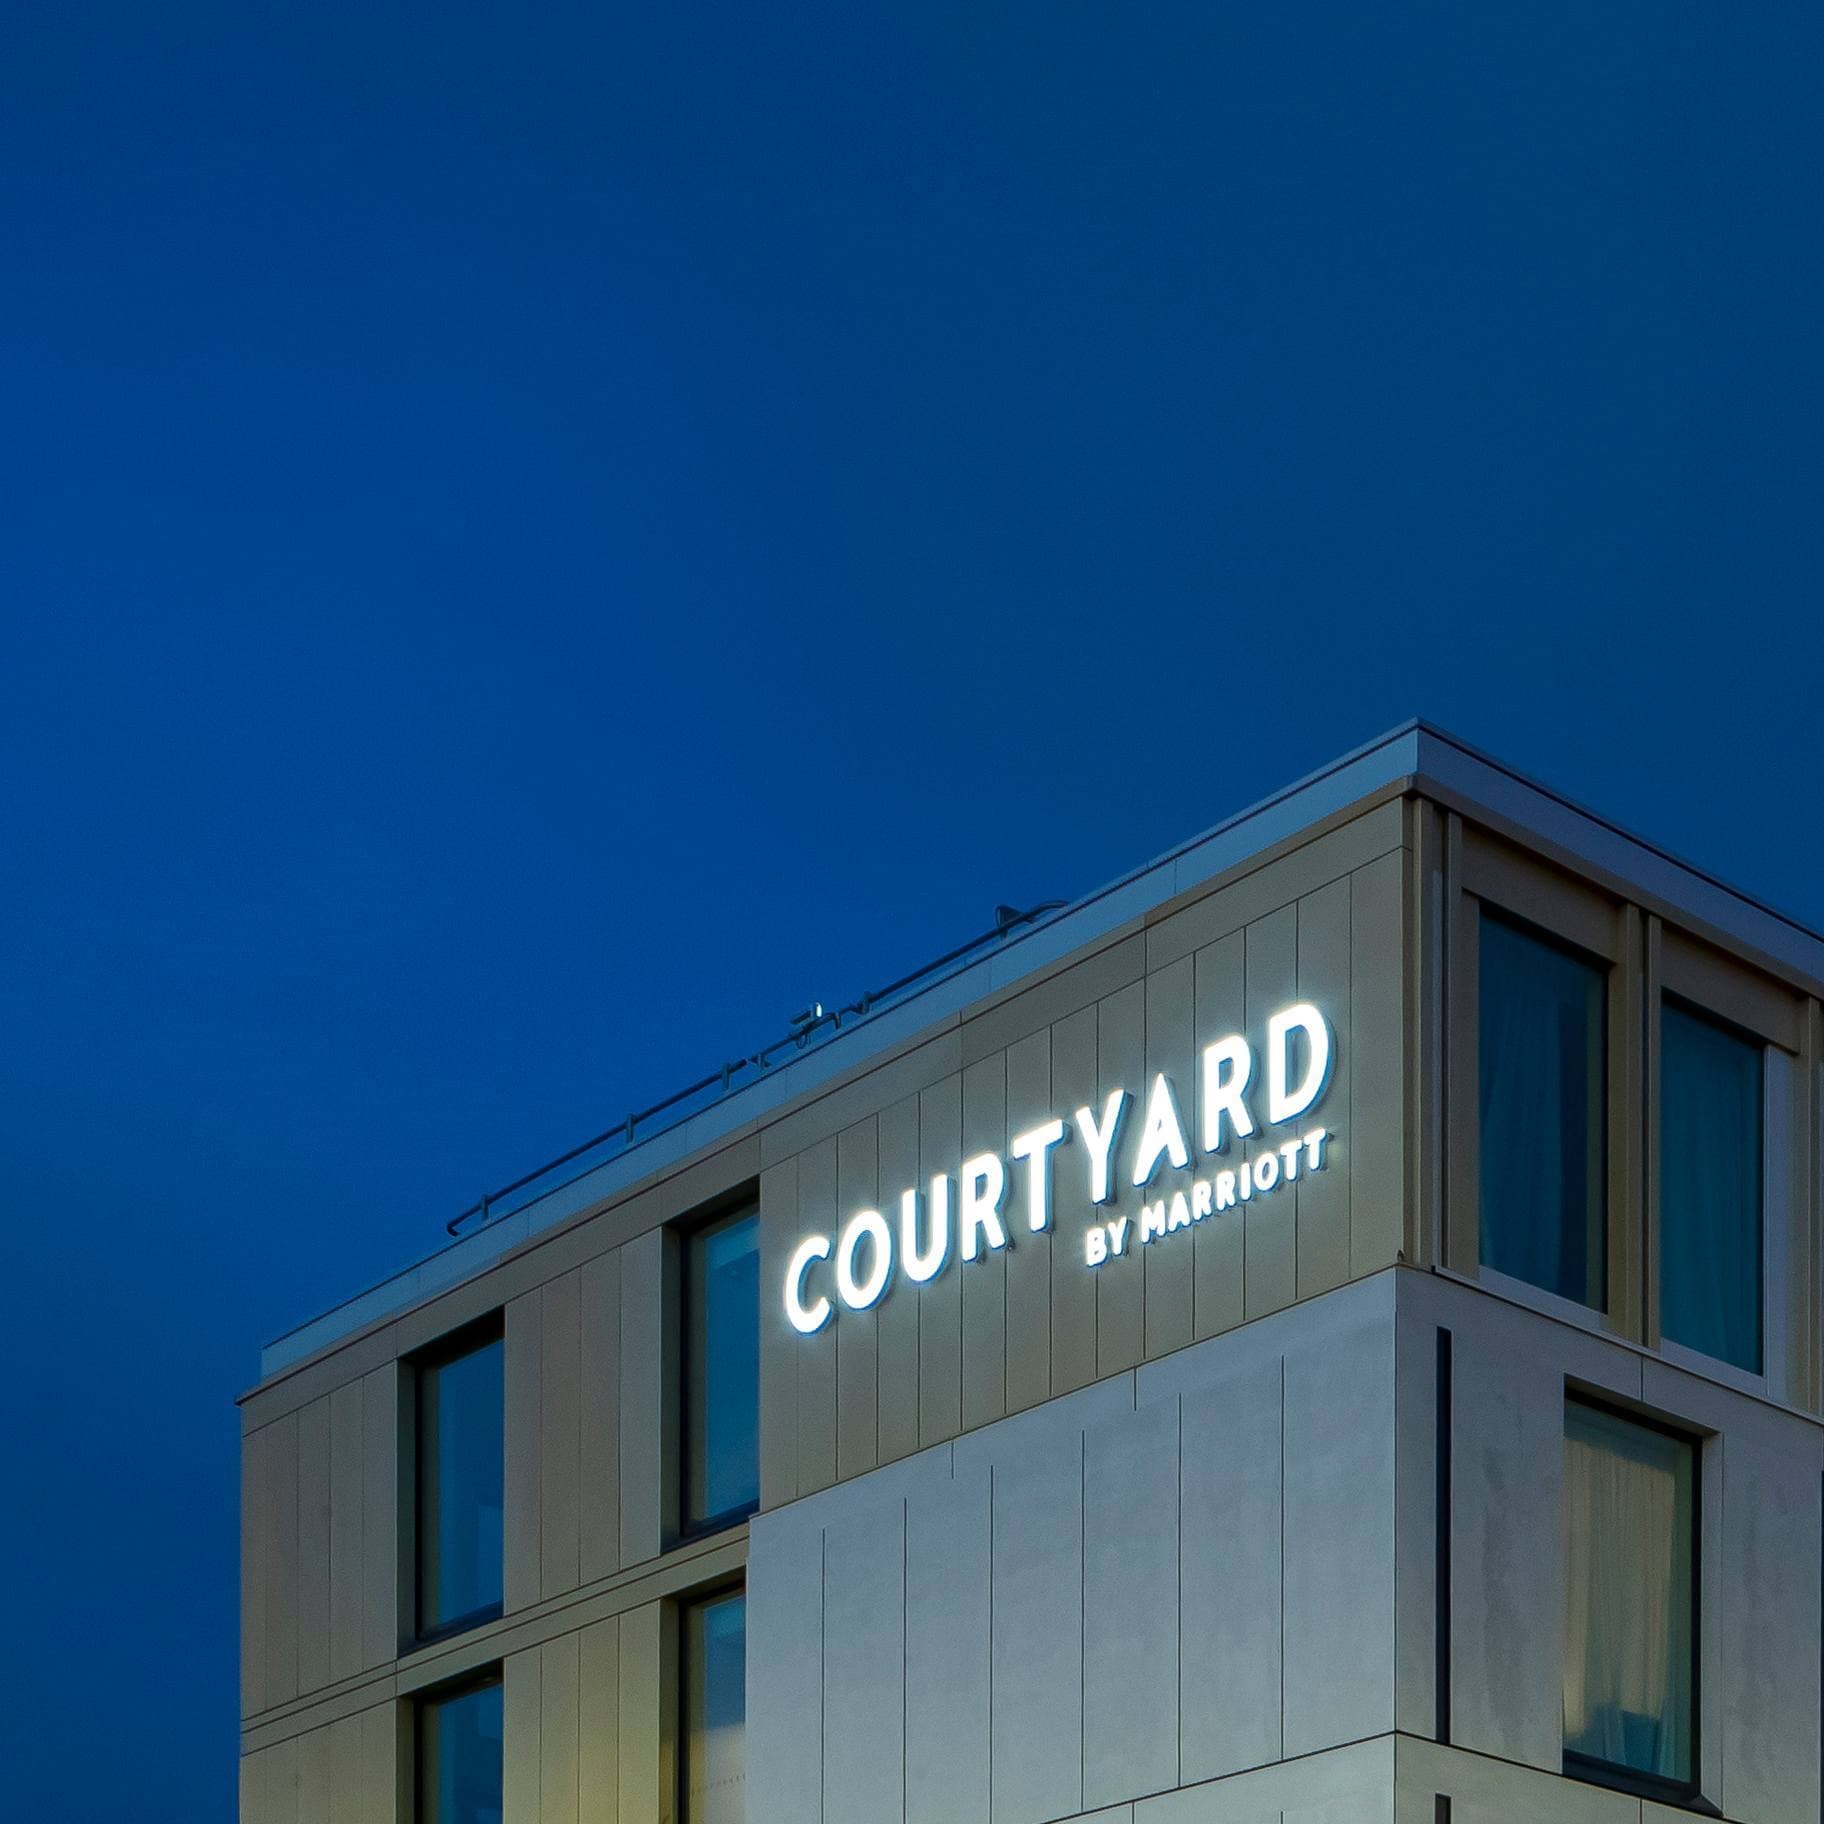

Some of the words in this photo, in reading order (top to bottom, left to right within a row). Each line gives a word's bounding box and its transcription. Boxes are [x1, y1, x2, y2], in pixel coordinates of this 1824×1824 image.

[784, 1002, 1335, 1335] COURTYARD
[1085, 1217, 1130, 1267] BY
[1140, 1127, 1328, 1244] MARRIOTT
